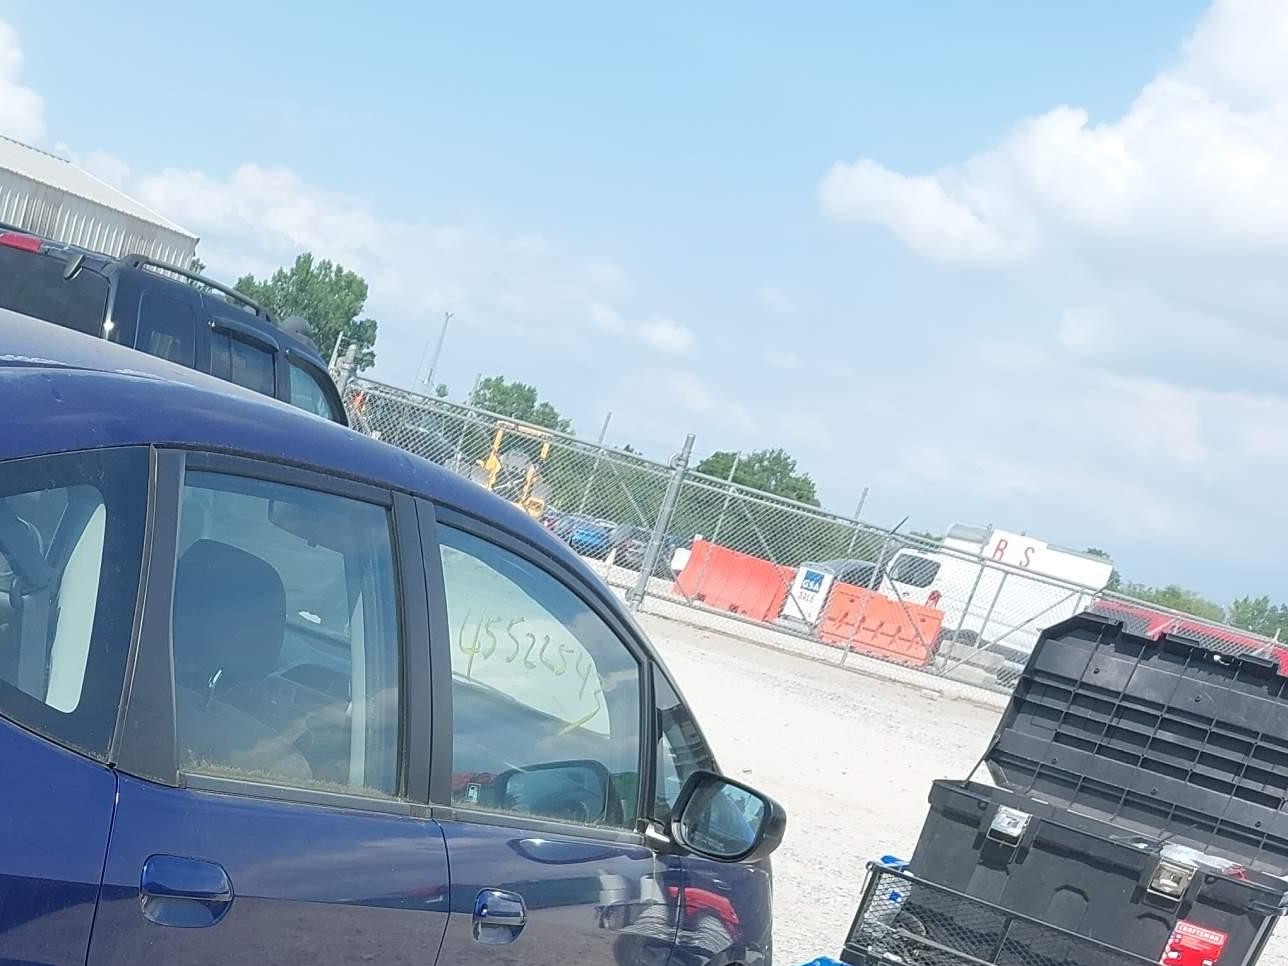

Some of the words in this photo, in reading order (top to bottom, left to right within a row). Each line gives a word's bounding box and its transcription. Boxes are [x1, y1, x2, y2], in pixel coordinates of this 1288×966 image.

[1019, 546, 1035, 568] S
[802, 579, 820, 591] GSA
[1179, 924, 1220, 943] CRAFTSMAN
